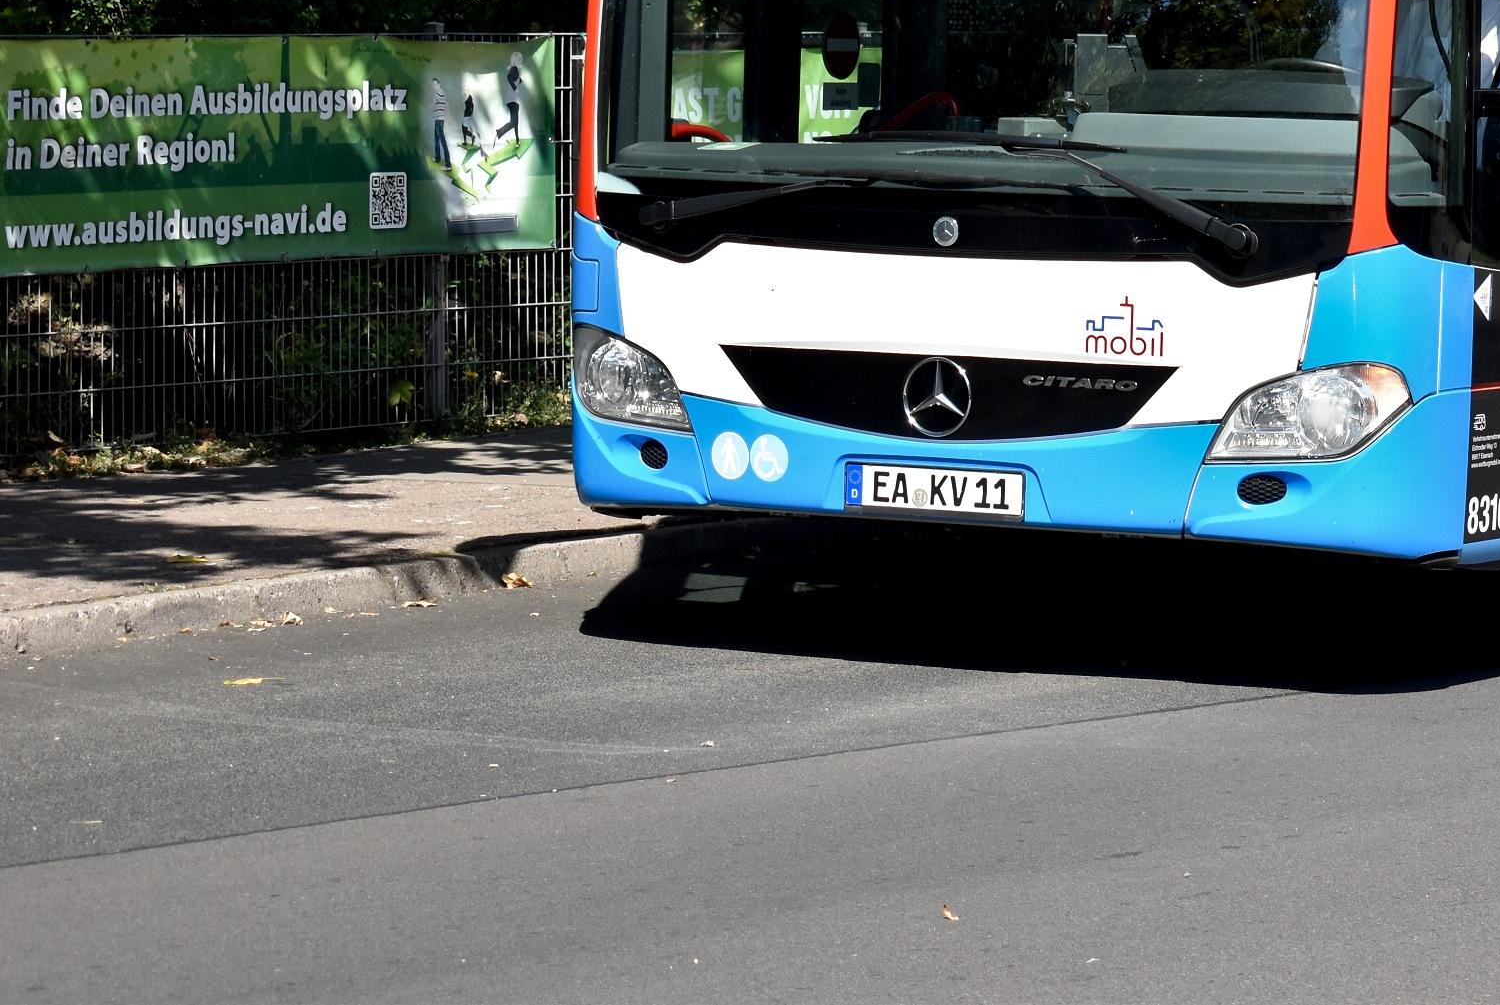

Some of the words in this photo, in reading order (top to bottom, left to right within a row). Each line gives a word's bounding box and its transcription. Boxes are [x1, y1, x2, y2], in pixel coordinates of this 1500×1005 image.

[7, 89, 83, 122] Finde
[89, 86, 184, 121] Deinen
[189, 80, 407, 120] Ausbildungsplatz
[6, 139, 32, 170] in
[39, 138, 130, 169] Deiner
[137, 132, 235, 172] Region!
[5, 203, 347, 251] www.ausbildungs-navi.de
[1085, 304, 1164, 357] mobil
[1022, 374, 1138, 392] CITARO
[872, 471, 909, 504] EA
[929, 474, 968, 507] KV
[974, 477, 1010, 510] 11
